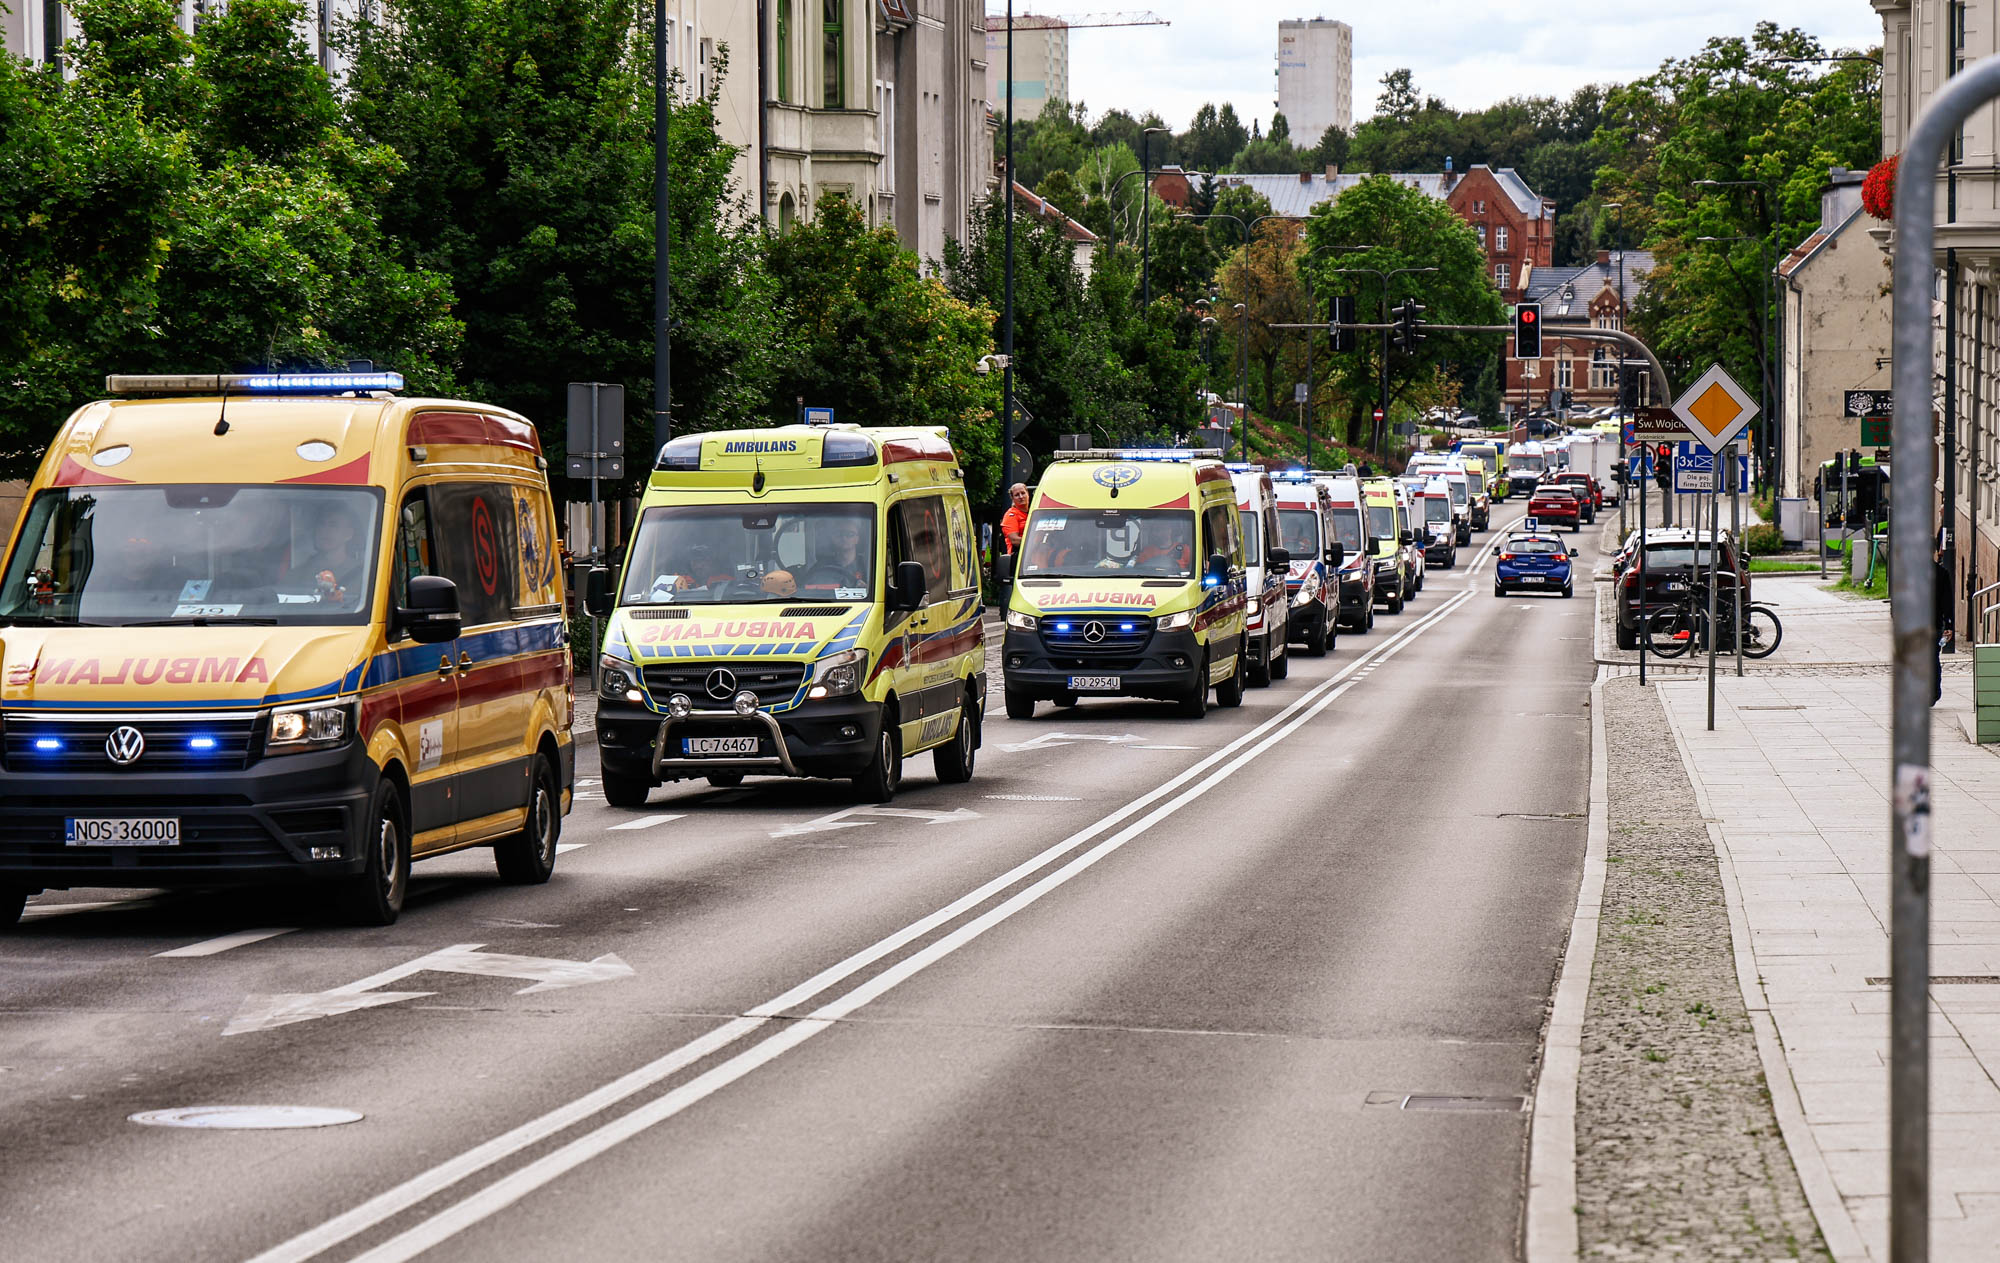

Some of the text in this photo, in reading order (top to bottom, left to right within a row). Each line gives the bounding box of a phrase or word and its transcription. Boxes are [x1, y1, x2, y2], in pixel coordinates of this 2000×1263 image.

[1638, 417, 1654, 429] Św.
[725, 440, 797, 453] AMBULANS
[1680, 456, 1693, 467] 3x
[1699, 474, 1711, 482] poj.
[1527, 519, 1535, 528] L
[477, 514, 494, 578] S
[190, 607, 224, 615] 49
[1089, 678, 1118, 687] 2954U
[691, 739, 709, 752] LC
[713, 738, 755, 752] 76467
[76, 821, 112, 840] NOS
[119, 821, 177, 840] 36000
